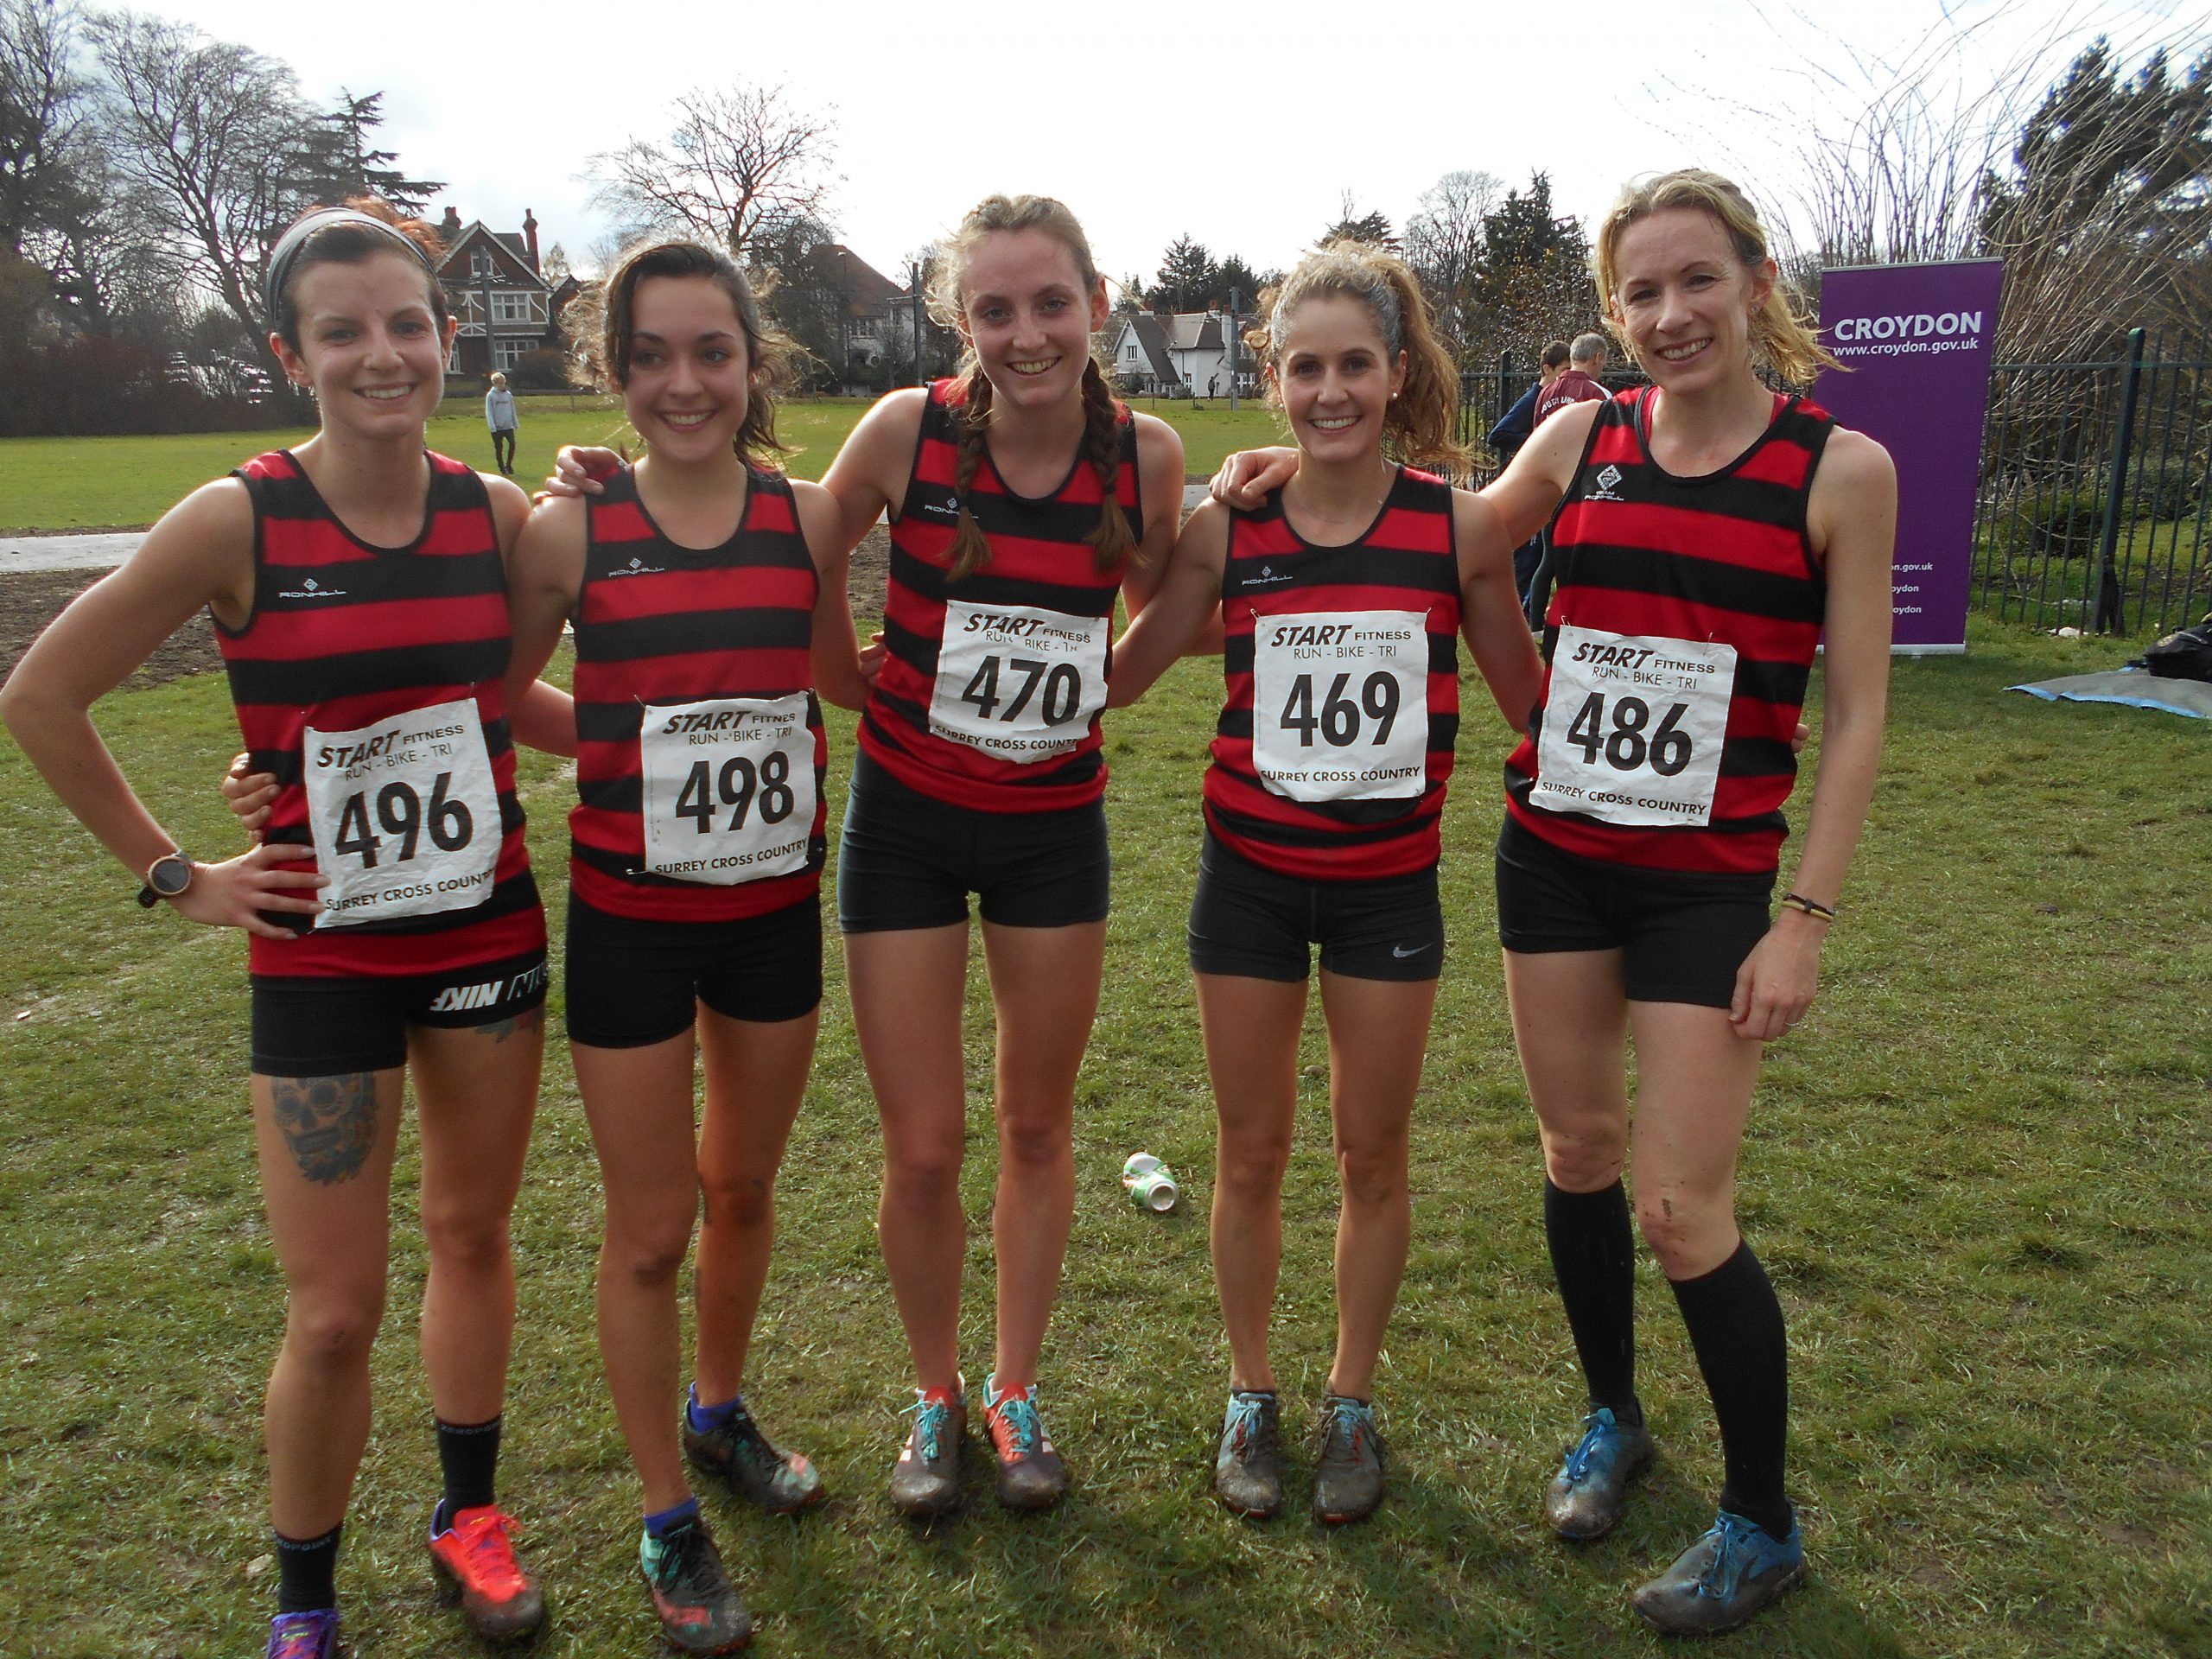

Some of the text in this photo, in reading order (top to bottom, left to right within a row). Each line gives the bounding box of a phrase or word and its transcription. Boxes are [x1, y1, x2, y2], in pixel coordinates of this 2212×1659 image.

[1834, 311, 1981, 340] CROYDON
[1834, 337, 1979, 357] www.croydon.gov.uk
[963, 613, 1090, 643] START FITNESS
[1271, 625, 1412, 647] START FITNESS
[1025, 639, 1050, 651] BIKE
[1294, 648, 1322, 659] RUN
[1337, 646, 1364, 658] BIKE
[1378, 645, 1396, 657] TRI
[1572, 642, 1715, 674] START FITNESS
[961, 655, 1081, 727] 470
[1592, 666, 1619, 679] RUN
[1633, 671, 1662, 686] BIKE
[1677, 677, 1697, 690] TRI
[662, 710, 752, 734] START
[1280, 671, 1401, 747] 469
[317, 724, 464, 768] START FITNESS
[689, 733, 718, 746] RUN
[734, 730, 762, 742] BIKE
[774, 727, 792, 739] TRI
[985, 738, 1027, 750] CROSS
[1030, 738, 1080, 750] COUNTR
[1566, 691, 1693, 777] 486
[345, 763, 372, 781] RUN
[386, 751, 417, 768] BIKE
[430, 742, 452, 758] TRI
[1261, 766, 1421, 782] SURREY CROSS COUNTRY
[676, 751, 794, 835] 498
[1541, 782, 1707, 816] SURREY CROSS COUNTRY
[334, 772, 474, 869] 496
[655, 838, 807, 874] SURREY CROSS COUNTRY
[325, 868, 493, 912] SURREY CROSS COUNT
